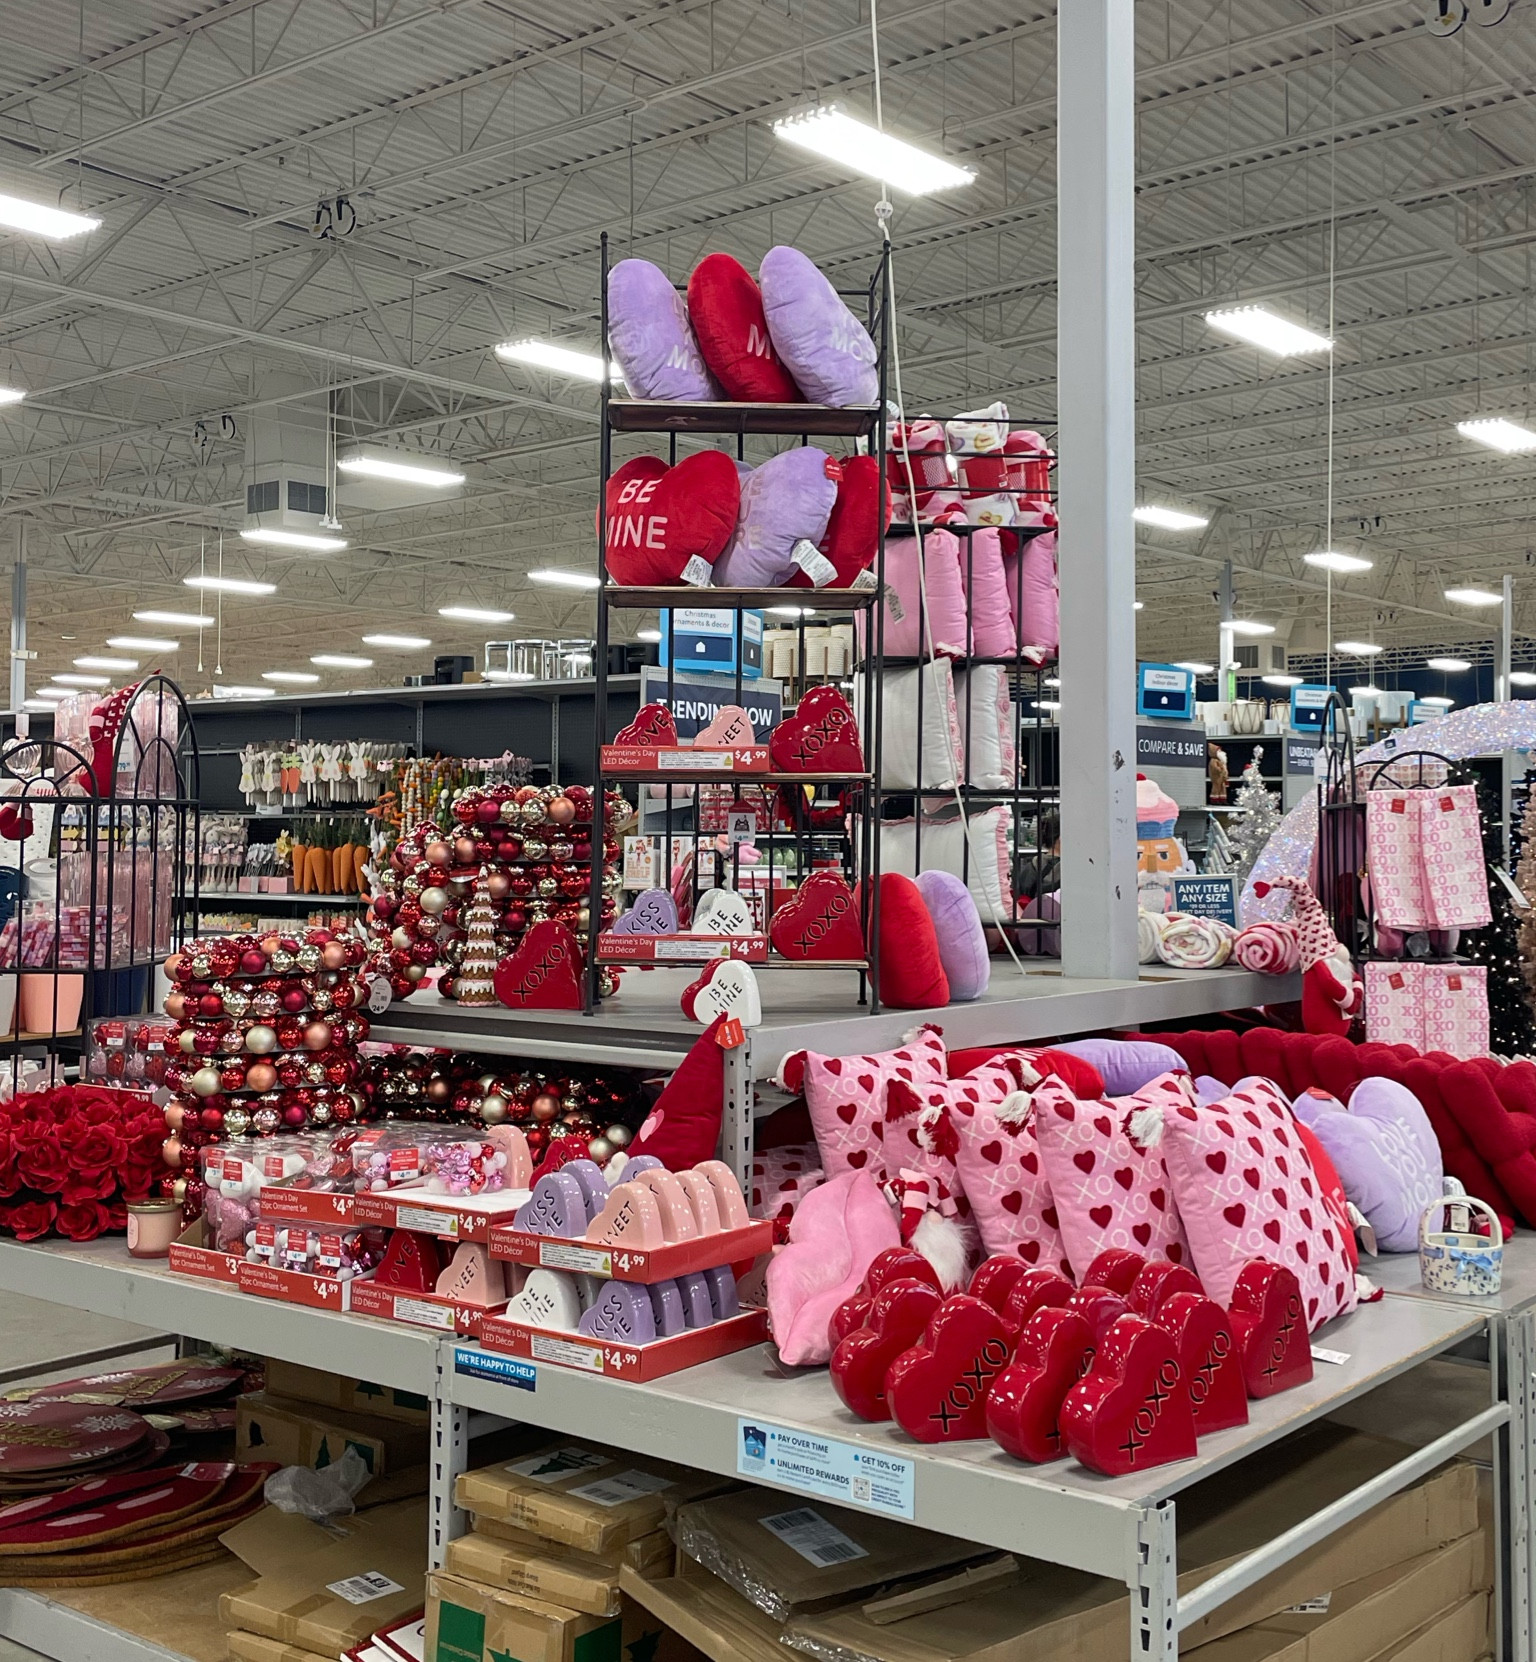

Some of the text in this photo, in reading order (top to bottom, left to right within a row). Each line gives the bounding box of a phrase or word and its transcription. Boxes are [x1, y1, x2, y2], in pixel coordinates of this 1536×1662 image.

[617, 478, 663, 504] BE
[673, 618, 705, 628] rnaments
[706, 619, 711, 627] &
[684, 609, 717, 620] Christmas
[744, 706, 773, 726] OW
[637, 714, 669, 747] OVE
[717, 716, 746, 746] WEET
[791, 707, 848, 768] XOXO
[603, 749, 656, 759] Valentine's Day
[735, 750, 767, 766] $4.99
[1138, 739, 1204, 756] COMPARE & SAVE
[618, 757, 640, 765] Décor
[1178, 883, 1230, 894] ANY ITEM
[1181, 893, 1228, 903] ANY SIZE
[626, 901, 660, 935] KISS
[707, 909, 728, 932] BE
[718, 912, 744, 936] INE
[793, 895, 849, 954] XOXO
[600, 938, 653, 948] Valentine's Day
[600, 946, 637, 954] LED Décor
[732, 940, 764, 956] $4.99
[512, 945, 566, 1002] XOXO
[708, 978, 728, 1001] BE
[823, 1077, 857, 1101] XO
[835, 1125, 870, 1149] XO
[1056, 1122, 1095, 1150] XO
[1184, 1124, 1221, 1155] XO
[1370, 1116, 1418, 1164] LOVE
[1096, 1140, 1131, 1167] XO
[1389, 1141, 1426, 1187] YOU
[983, 1164, 1021, 1195] XO
[1133, 1159, 1161, 1186] XO
[261, 1192, 298, 1203] Valentine's Day
[1072, 1175, 1113, 1204] XO
[1204, 1174, 1243, 1207] XO
[272, 1203, 299, 1212] Ornament
[299, 1205, 308, 1213] Set
[355, 1198, 395, 1211] Valentine's Day
[355, 1206, 365, 1215] LED
[524, 1189, 555, 1233] KISS
[1112, 1192, 1148, 1222] XO
[1246, 1191, 1277, 1221] XO
[460, 1213, 486, 1233] $4.99
[1001, 1214, 1040, 1243] XO
[1149, 1213, 1179, 1241] XO
[490, 1243, 502, 1253] LED
[491, 1233, 538, 1249] Valentine's Day
[1222, 1228, 1264, 1260] XO
[170, 1247, 207, 1262] Valentine's Day
[180, 1259, 205, 1270] Ornament
[206, 1263, 215, 1272] Set
[389, 1241, 414, 1283] OVE
[612, 1251, 645, 1272] $4.99
[240, 1267, 278, 1282] Valentine's Day
[253, 1278, 279, 1291] Ornament
[280, 1284, 288, 1293] Set
[314, 1280, 338, 1299] $4.99
[352, 1296, 363, 1305] LED
[353, 1286, 392, 1303] Valentine's Day
[519, 1287, 539, 1313] BE
[590, 1294, 622, 1338] KISS
[482, 1321, 529, 1341] Valentine's Day
[482, 1331, 495, 1342] LED
[1262, 1294, 1298, 1385] XOXO
[457, 1352, 535, 1378] WE'RE HAPPY TO HELP
[605, 1348, 637, 1371] $4.99
[1190, 1330, 1231, 1415] OXO
[928, 1338, 1008, 1435] XOXO
[1118, 1358, 1180, 1465] XOXO
[777, 1433, 829, 1453] PAY OVER TIME
[777, 1459, 815, 1476] UNLIMITED
[815, 1470, 850, 1485] REWARDS
[861, 1455, 906, 1473] GET 10% OFF
